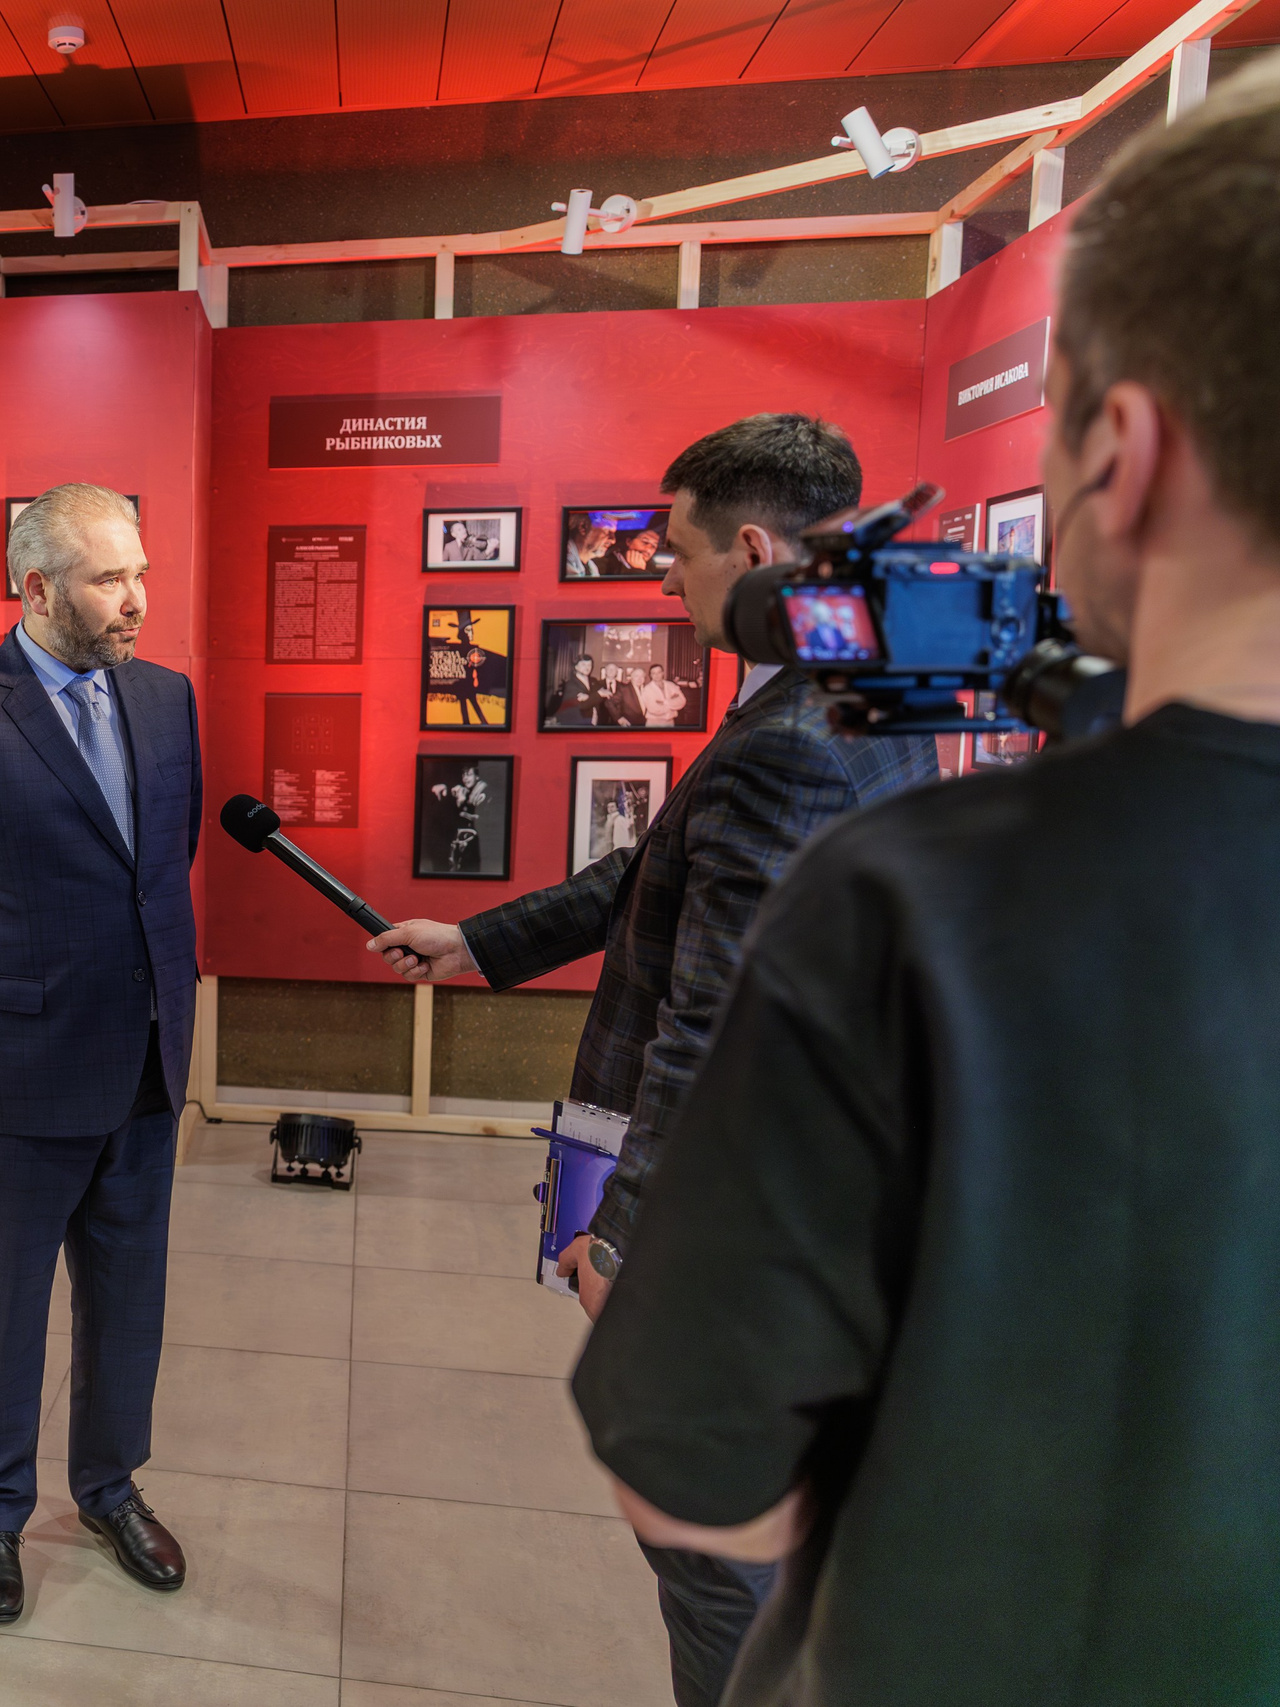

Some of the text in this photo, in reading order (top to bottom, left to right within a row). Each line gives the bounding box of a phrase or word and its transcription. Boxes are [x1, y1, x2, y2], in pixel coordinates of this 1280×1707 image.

[994, 361, 1029, 390] ИСАКОВА
[339, 416, 427, 434] ДИНАСТИЯ
[325, 434, 442, 451] РЫБНИКОВЫХ
